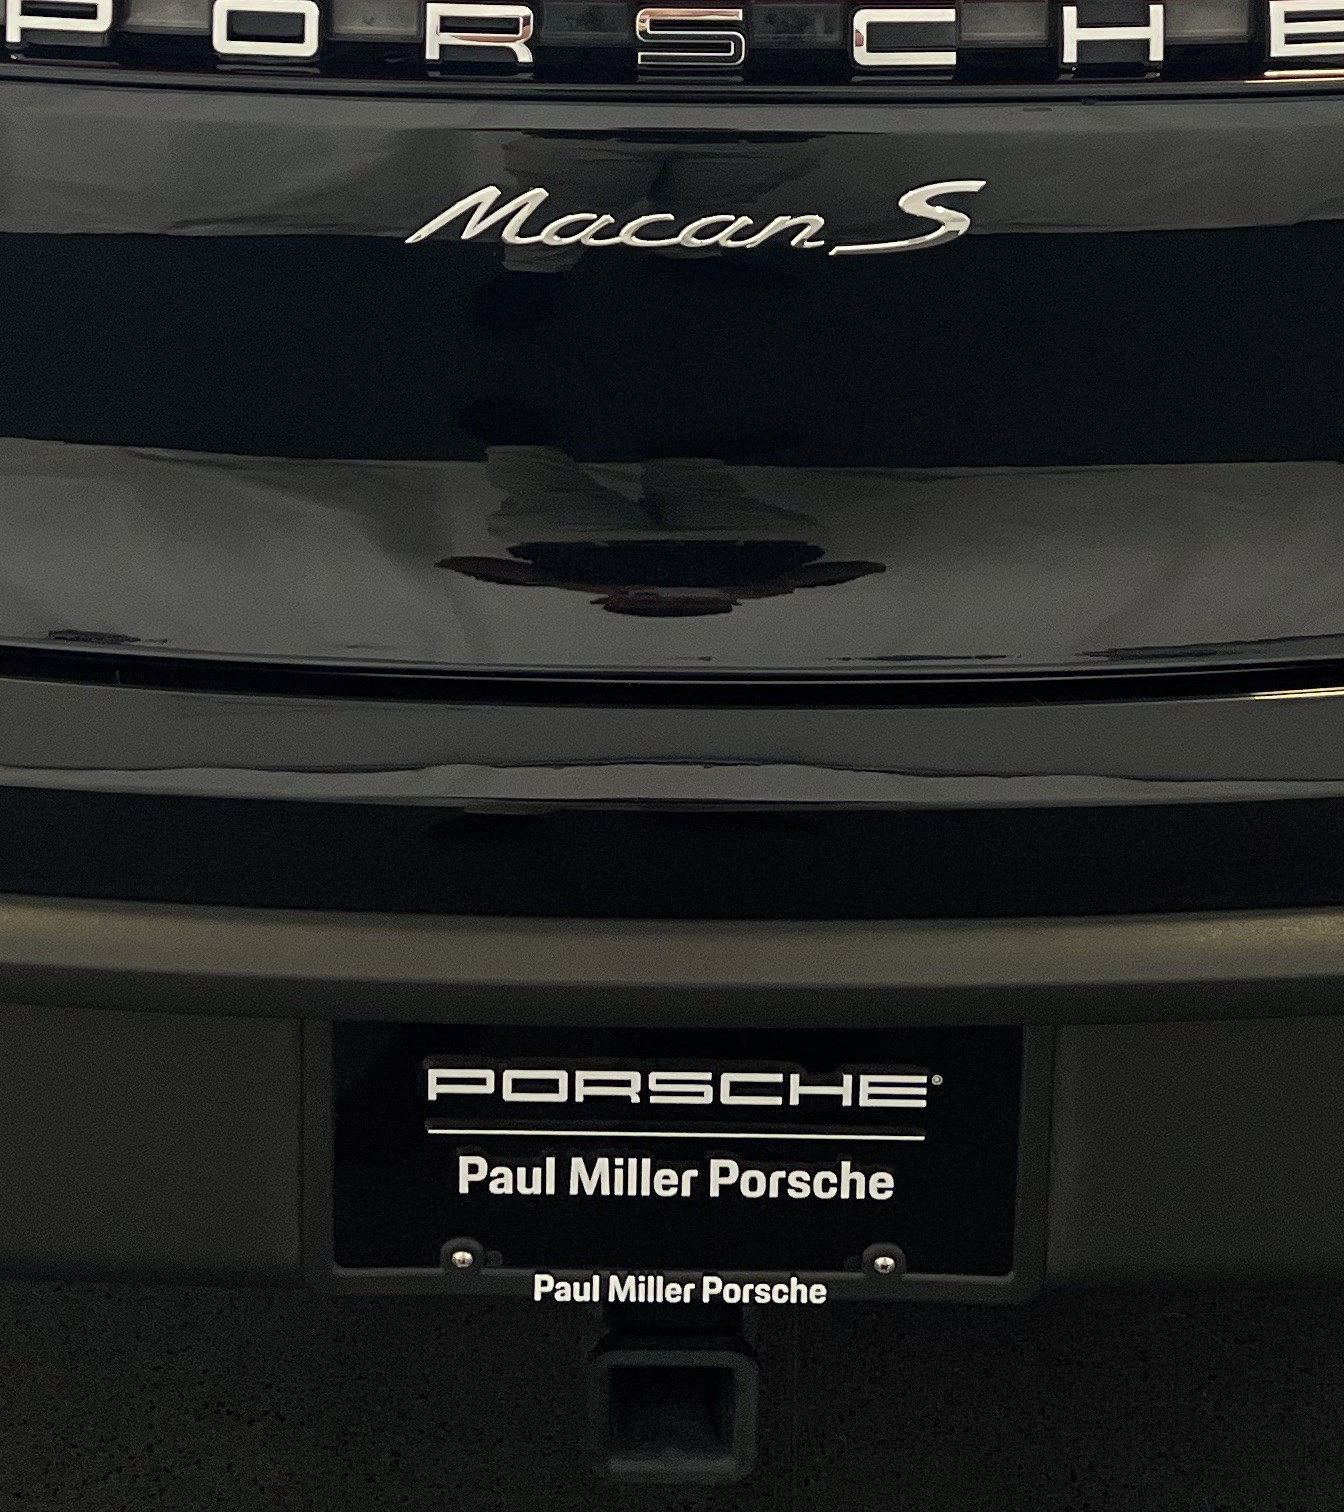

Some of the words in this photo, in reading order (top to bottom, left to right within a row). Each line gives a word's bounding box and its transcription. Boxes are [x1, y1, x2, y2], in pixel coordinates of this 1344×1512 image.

[404, 185, 826, 249] Macan
[828, 180, 987, 256] S
[457, 1154, 557, 1197] Paul
[568, 1155, 700, 1198] Miller
[708, 1157, 896, 1201] Porsche
[532, 1273, 601, 1304] Paul
[607, 1274, 696, 1305] Miller
[701, 1275, 829, 1306] Porsche
